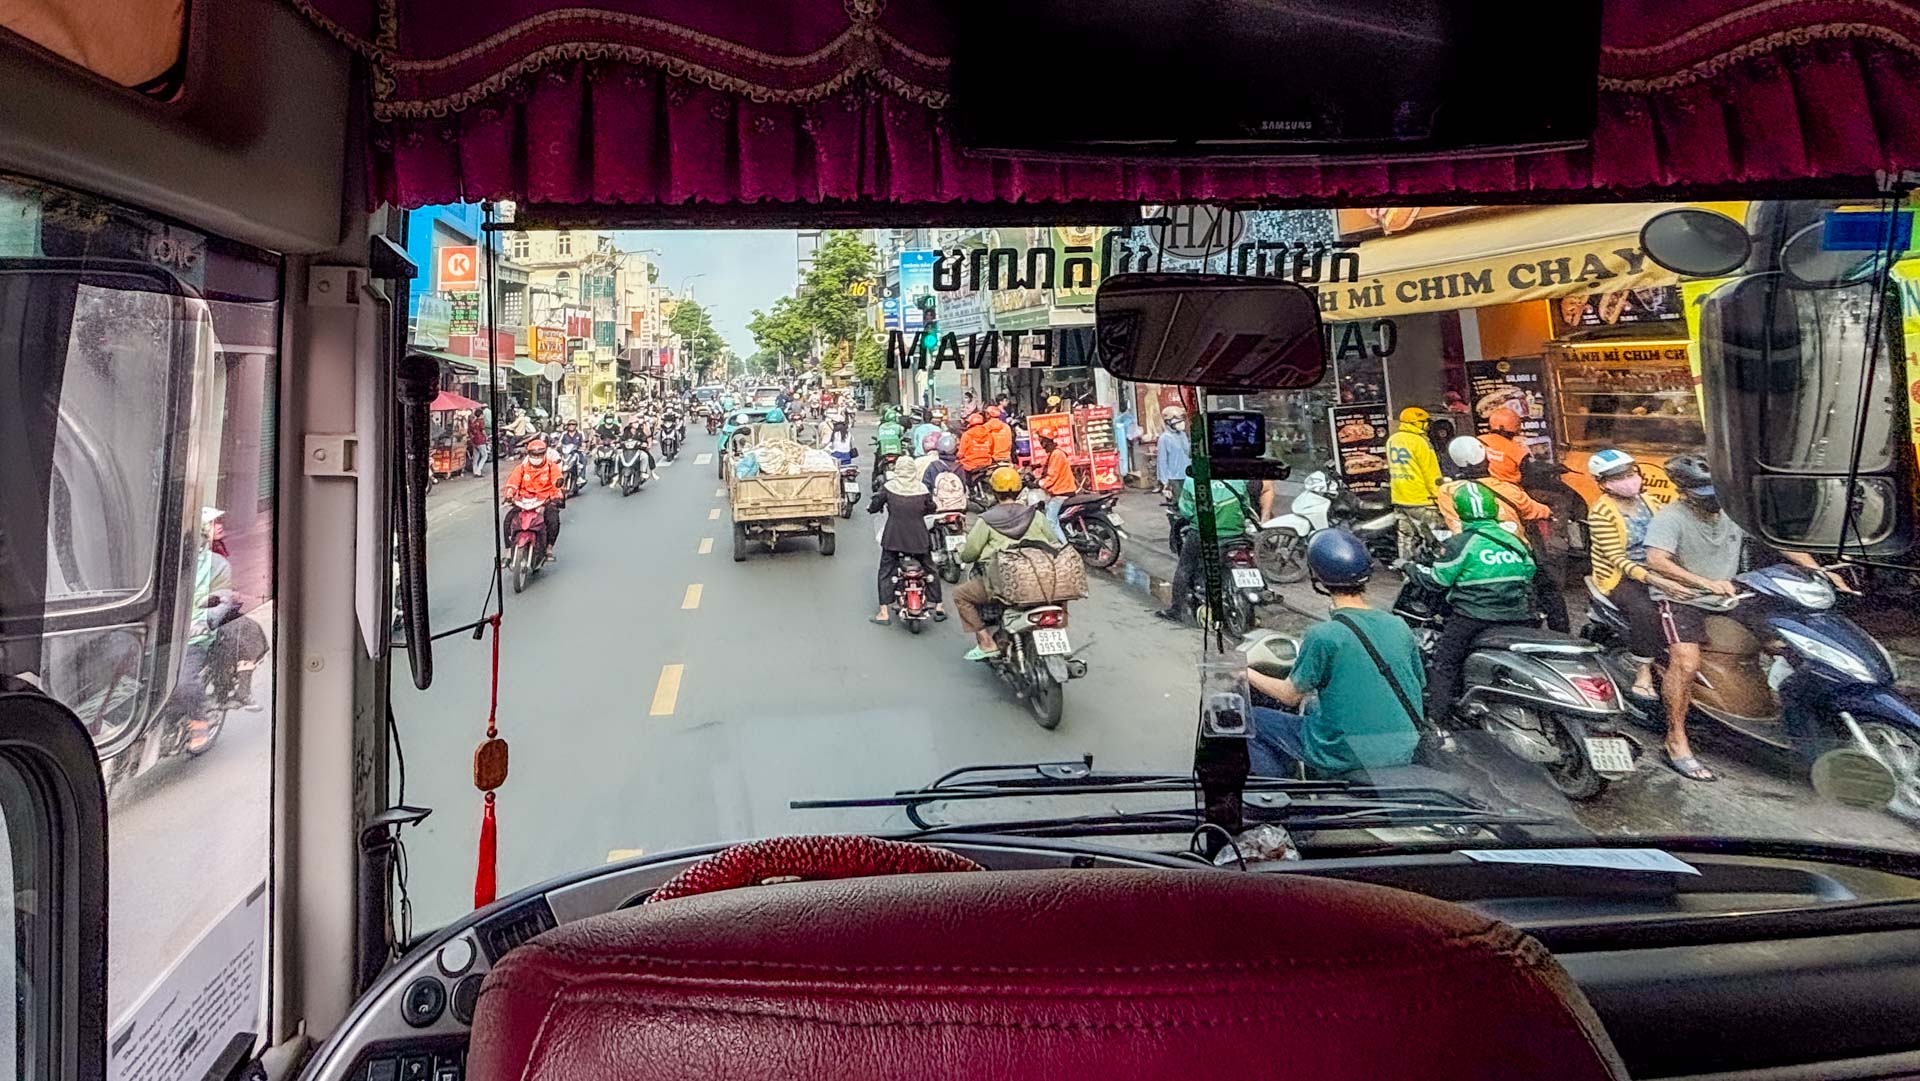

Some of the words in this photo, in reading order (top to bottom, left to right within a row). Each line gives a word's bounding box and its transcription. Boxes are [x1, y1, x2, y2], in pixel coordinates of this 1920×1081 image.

[1262, 120, 1313, 130] SAMSUNG
[453, 258, 466, 271] K
[1347, 278, 1385, 309] MÌ
[1395, 268, 1495, 303] CHIM
[1623, 349, 1660, 361] CHIM
[1389, 441, 1411, 464] be
